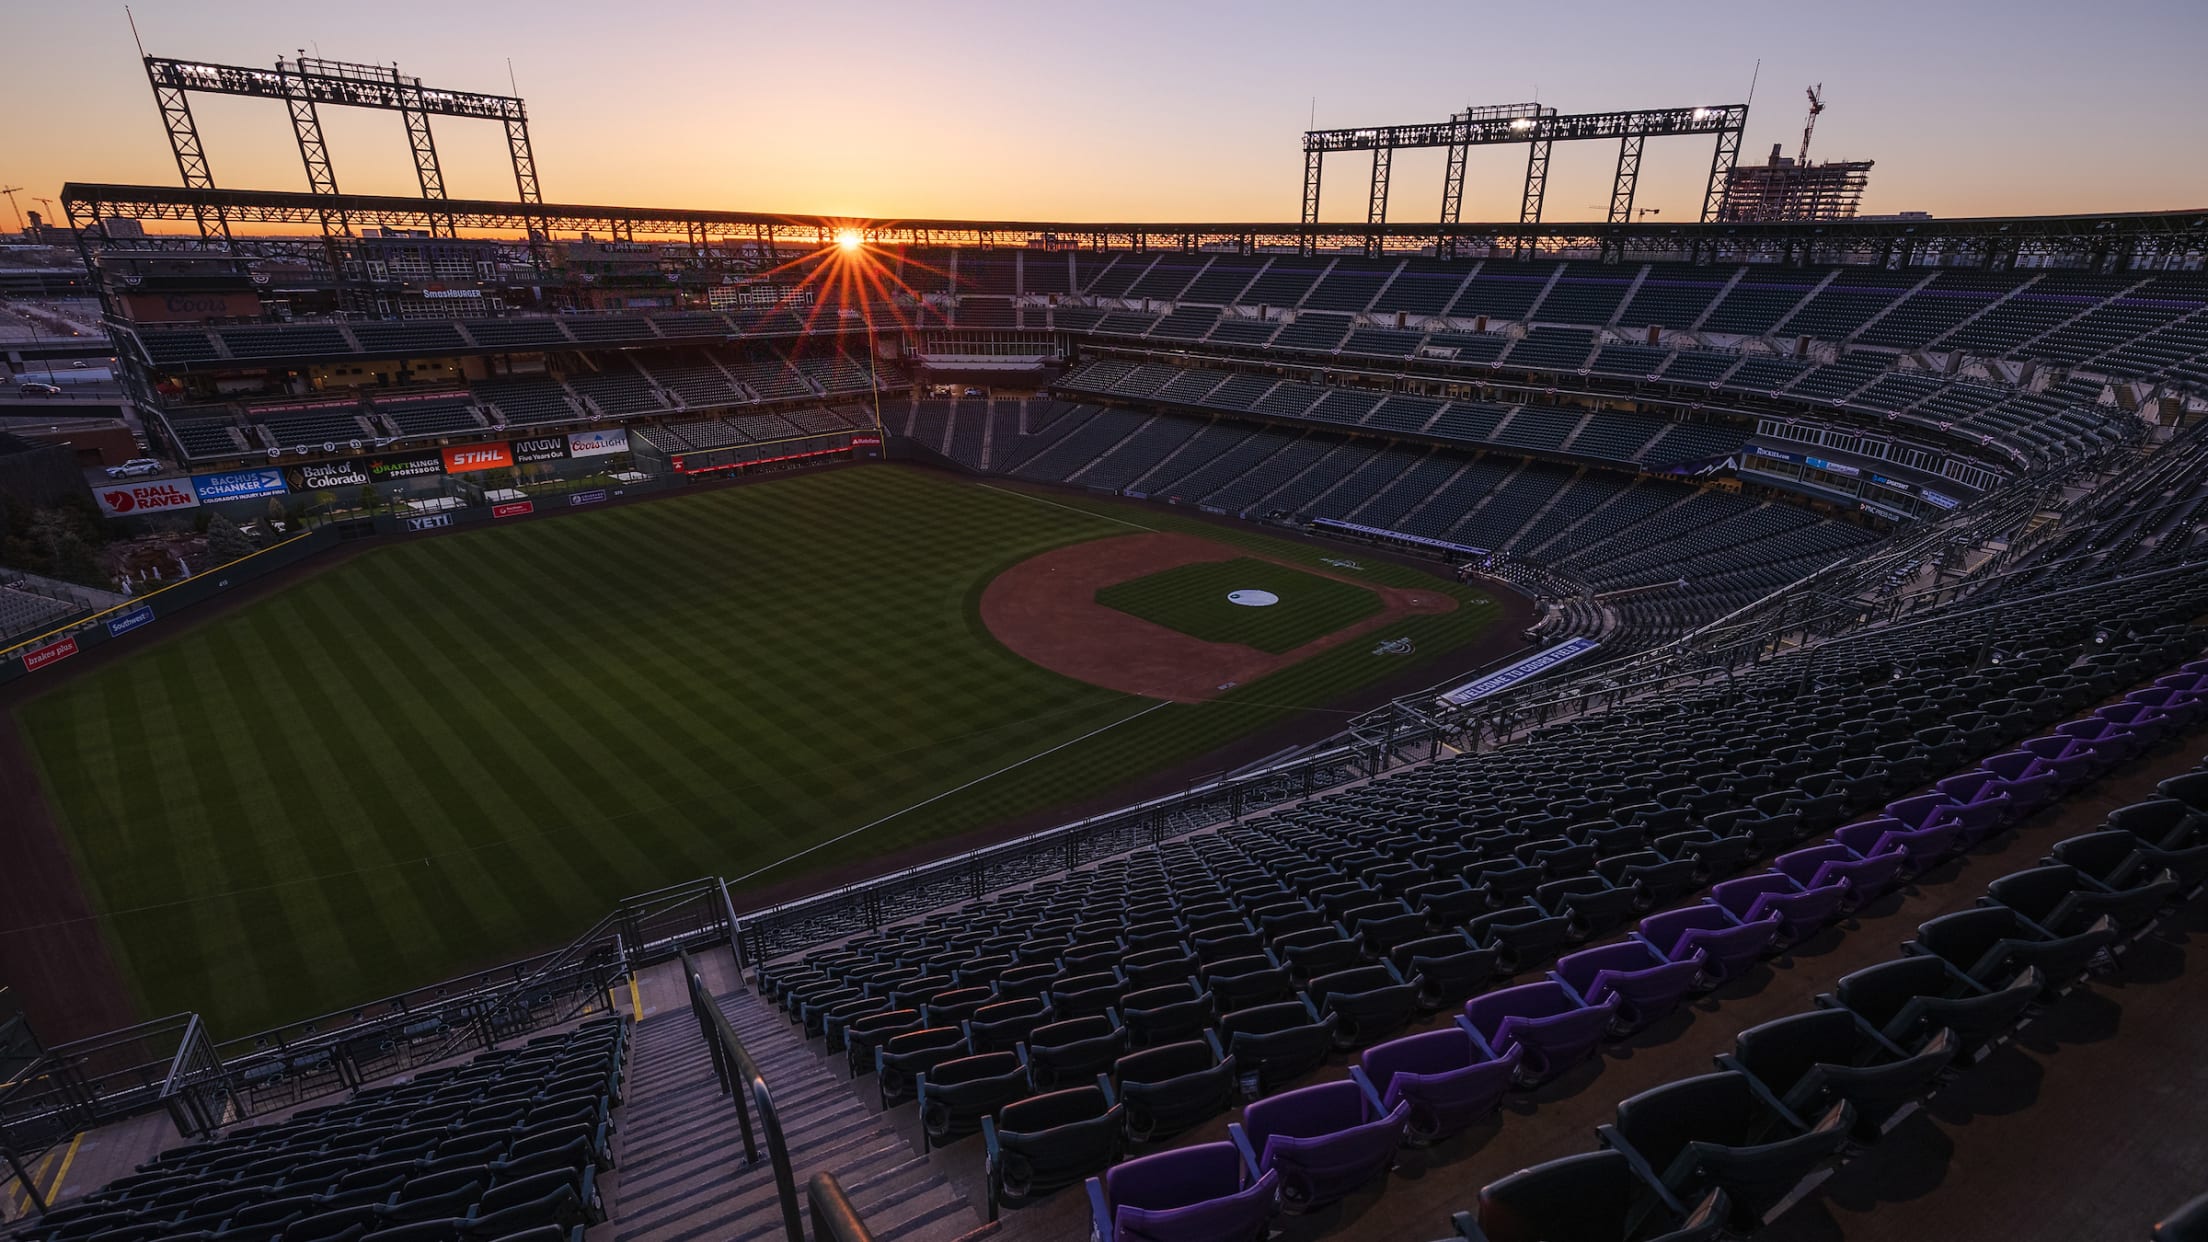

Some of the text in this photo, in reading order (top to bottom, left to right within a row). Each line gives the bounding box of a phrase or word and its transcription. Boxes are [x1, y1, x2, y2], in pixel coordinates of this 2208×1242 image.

[167, 295, 227, 313] Coors
[516, 438, 561, 453] ARROW
[572, 438, 627, 452] Coors LIGHT
[454, 449, 503, 465] STIHL
[518, 450, 564, 463] Five Years Out
[303, 461, 351, 477] Bank of
[372, 458, 439, 475] DRAFTKINGS
[390, 466, 441, 478] SPORTSBOOK
[211, 473, 258, 486] BACHUS
[307, 472, 366, 488] Colorado
[134, 485, 177, 499] FJALL
[199, 482, 261, 496] SCHANKER
[137, 493, 191, 509] RAVEN
[411, 514, 451, 529] YETI
[112, 613, 146, 632] Southwest
[28, 643, 73, 666] brakes plus
[1456, 644, 1580, 700] WELCOME TO COORS FIELD
